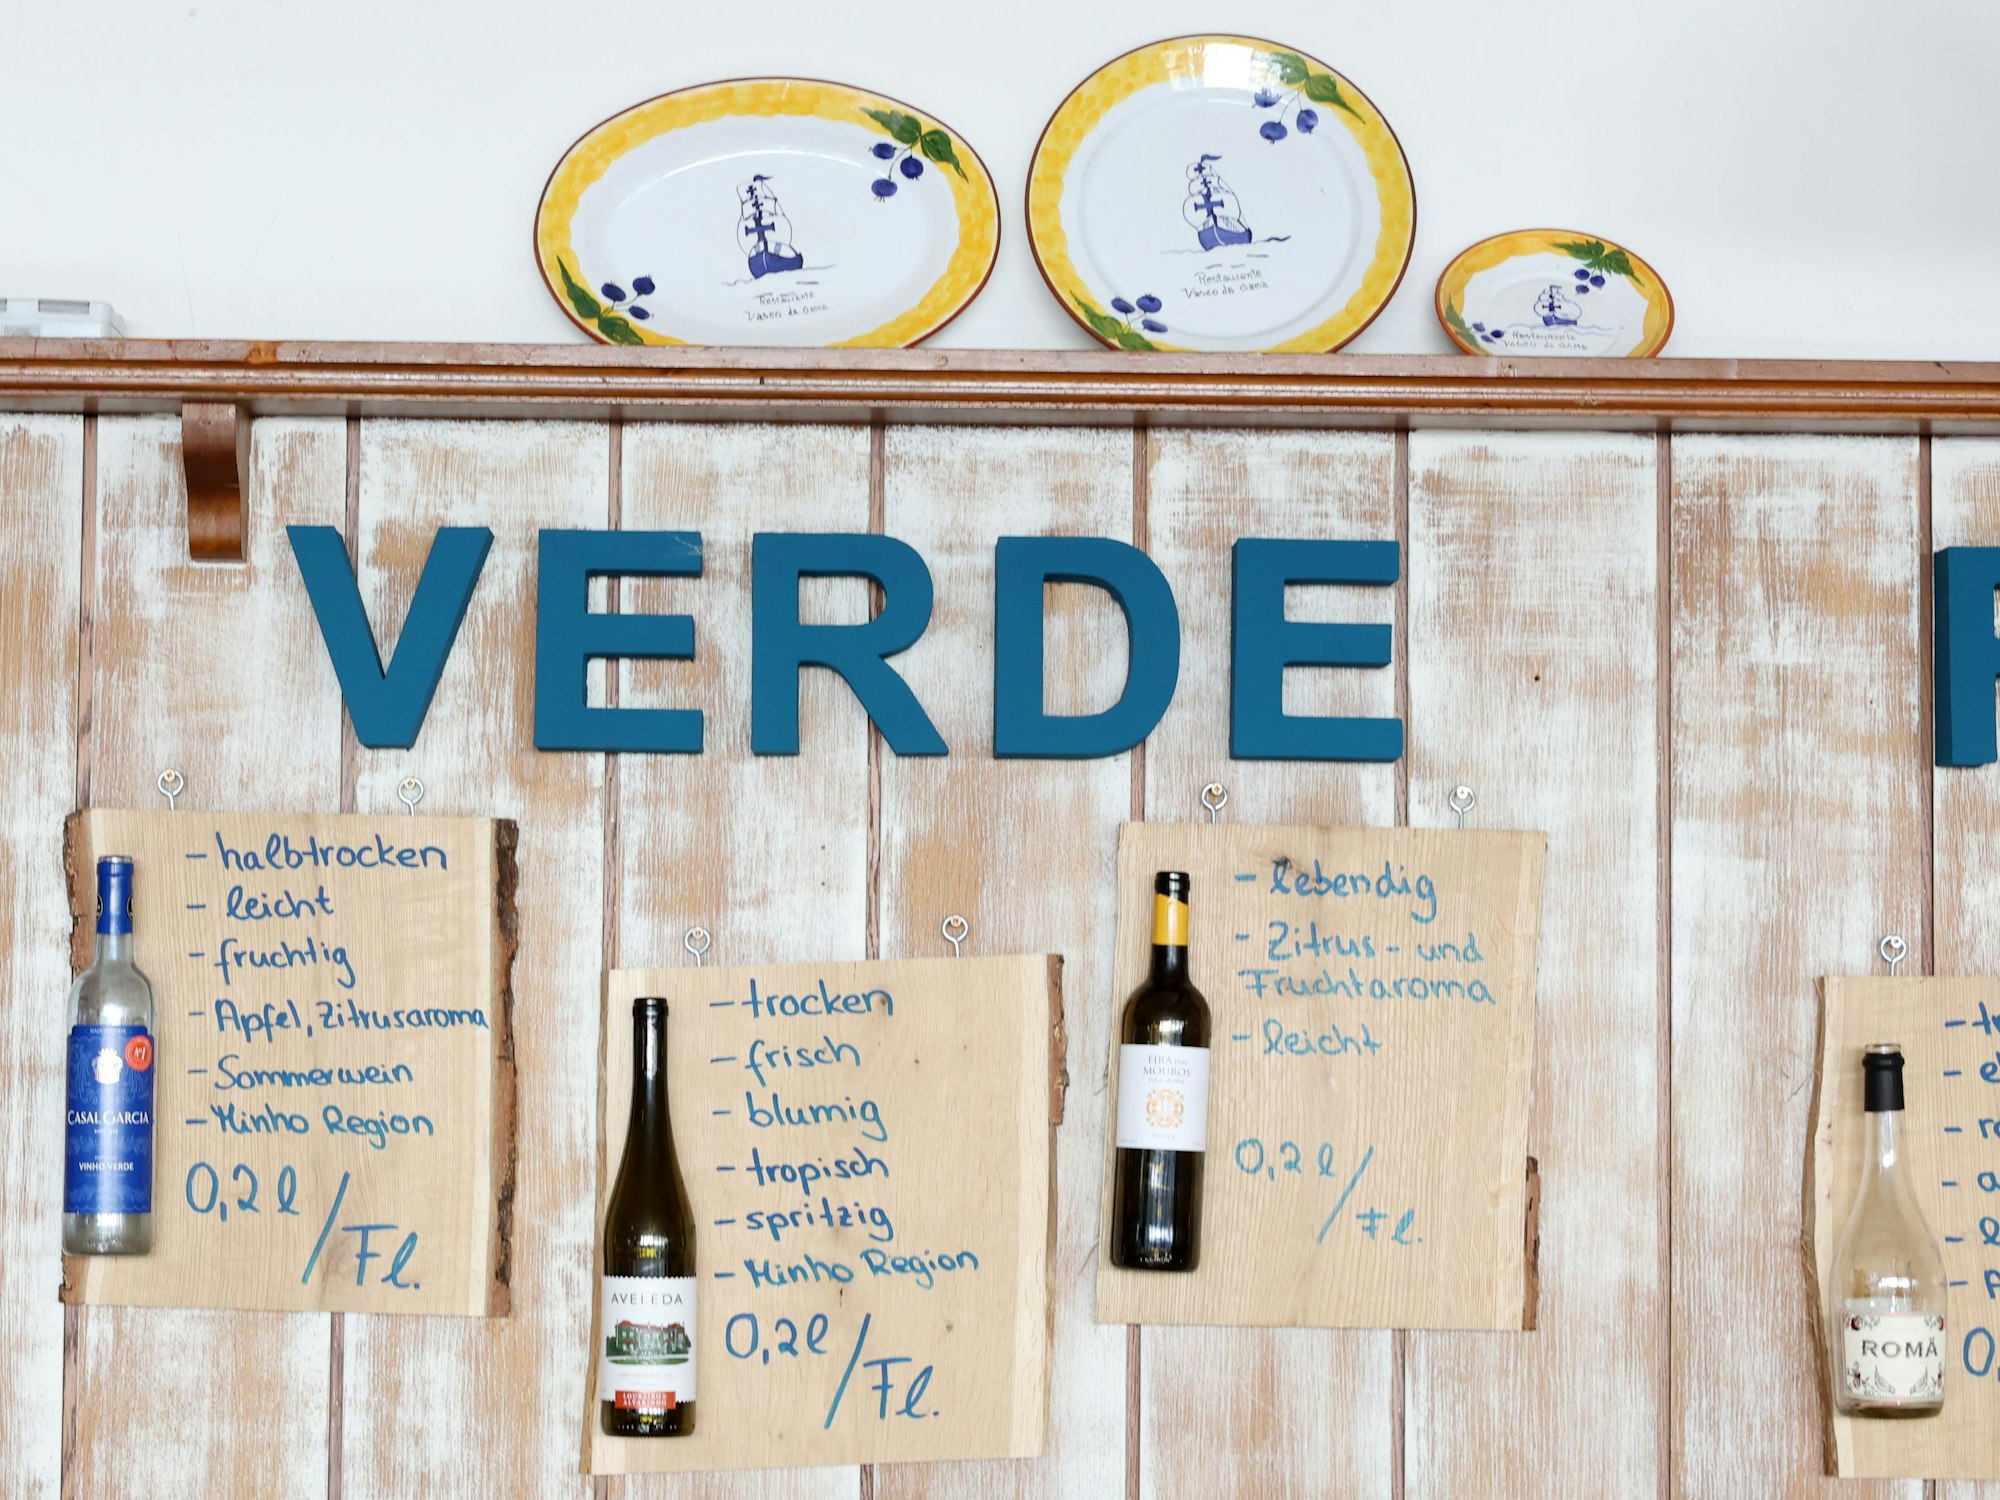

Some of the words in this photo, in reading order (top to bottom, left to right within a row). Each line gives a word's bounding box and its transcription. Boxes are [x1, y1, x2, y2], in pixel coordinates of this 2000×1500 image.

[1181, 287, 1219, 299] Vasco
[1222, 284, 1234, 295] da
[745, 309, 782, 322] Vasco
[286, 525, 1404, 760] VERDE
[216, 832, 448, 872] halbtrocken
[227, 885, 334, 921] leicht
[1269, 859, 1437, 923] lebendig
[215, 937, 356, 989] fruchtig
[1416, 932, 1485, 964] und
[742, 978, 894, 1019] trocken
[1238, 967, 1496, 1005] Fruchtaroma
[1263, 1018, 1382, 1057] leicht
[214, 1054, 414, 1090] Sommerwein
[745, 1036, 861, 1087] frisch
[1143, 1066, 1191, 1078] MOUROS
[68, 1109, 102, 1126] CASAL
[102, 1109, 149, 1126] GARCIA
[322, 1103, 434, 1150] Region
[745, 1091, 889, 1142] blumig
[79, 1161, 106, 1172] VINHO
[107, 1161, 134, 1172] VERDE
[746, 1147, 890, 1197] tropisch
[746, 1197, 895, 1242] spritzig
[860, 1248, 979, 1290] Region
[611, 1291, 683, 1305] AVELEDA
